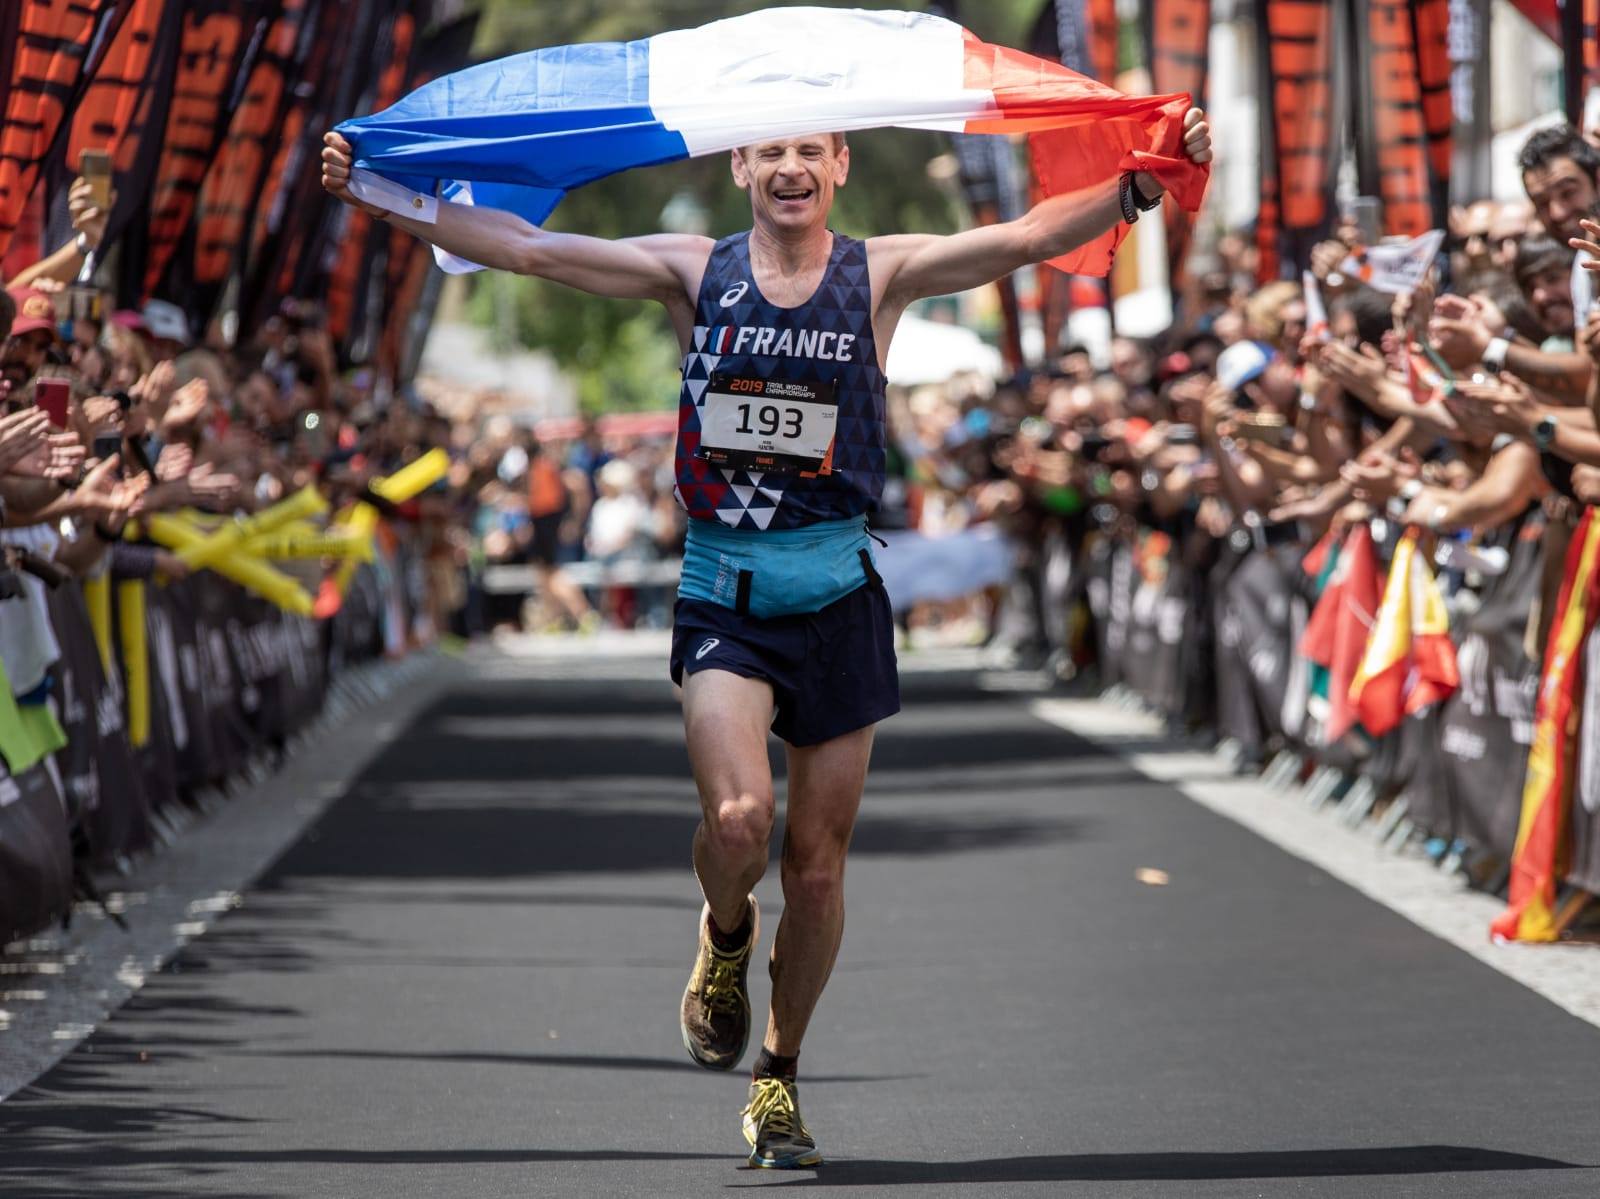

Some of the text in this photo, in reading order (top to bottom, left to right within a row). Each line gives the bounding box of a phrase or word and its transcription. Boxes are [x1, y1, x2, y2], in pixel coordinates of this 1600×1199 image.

[733, 326, 856, 362] FRANCE
[729, 378, 764, 393] 2019
[765, 387, 816, 398] CHAMPIONSHIPS
[766, 381, 809, 392] TRAIL WORLD
[735, 403, 804, 439] 193
